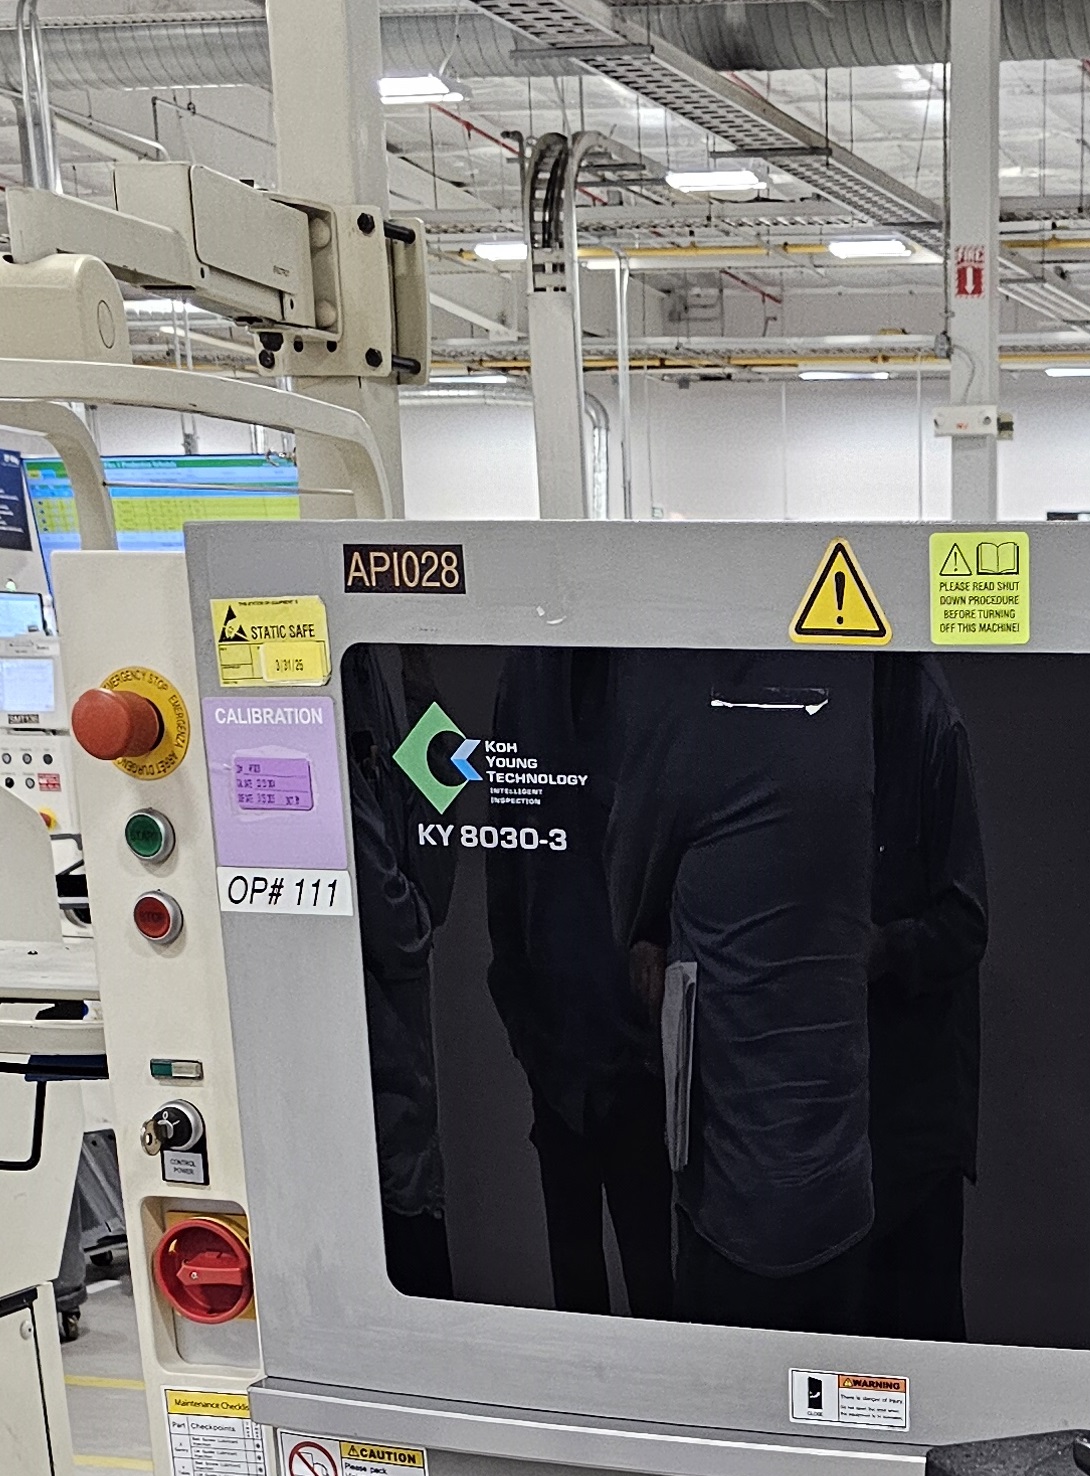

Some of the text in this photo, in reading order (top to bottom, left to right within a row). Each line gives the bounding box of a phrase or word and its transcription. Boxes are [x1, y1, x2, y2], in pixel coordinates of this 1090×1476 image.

[347, 551, 459, 588] API028
[939, 581, 1020, 591] PLEASE READ SHUT
[940, 595, 1020, 605] DOWN PROCEDURE
[944, 609, 1016, 619] BEFORE TURNING
[251, 624, 316, 640] STATIC SAFE
[940, 623, 1020, 633] OFF THIS MACHINE!
[215, 707, 324, 725] CALIBRATION
[485, 740, 518, 753] KOH
[486, 756, 538, 769] YOUNG
[486, 771, 589, 786] TECHNOLOGY
[490, 787, 543, 796] INTELLIGENT
[490, 796, 541, 806] INSPECTION
[418, 823, 568, 851] KY 8030-3
[228, 875, 338, 907] OP# 111
[170, 1158, 197, 1168] CONTROL
[173, 1167, 195, 1175] POWER
[852, 1379, 901, 1390] WARNING
[174, 1398, 249, 1411] Maintenance Checklis
[191, 1422, 236, 1432] Checkpoints
[360, 1448, 417, 1464] CAUTION
[345, 1462, 367, 1472] Please
